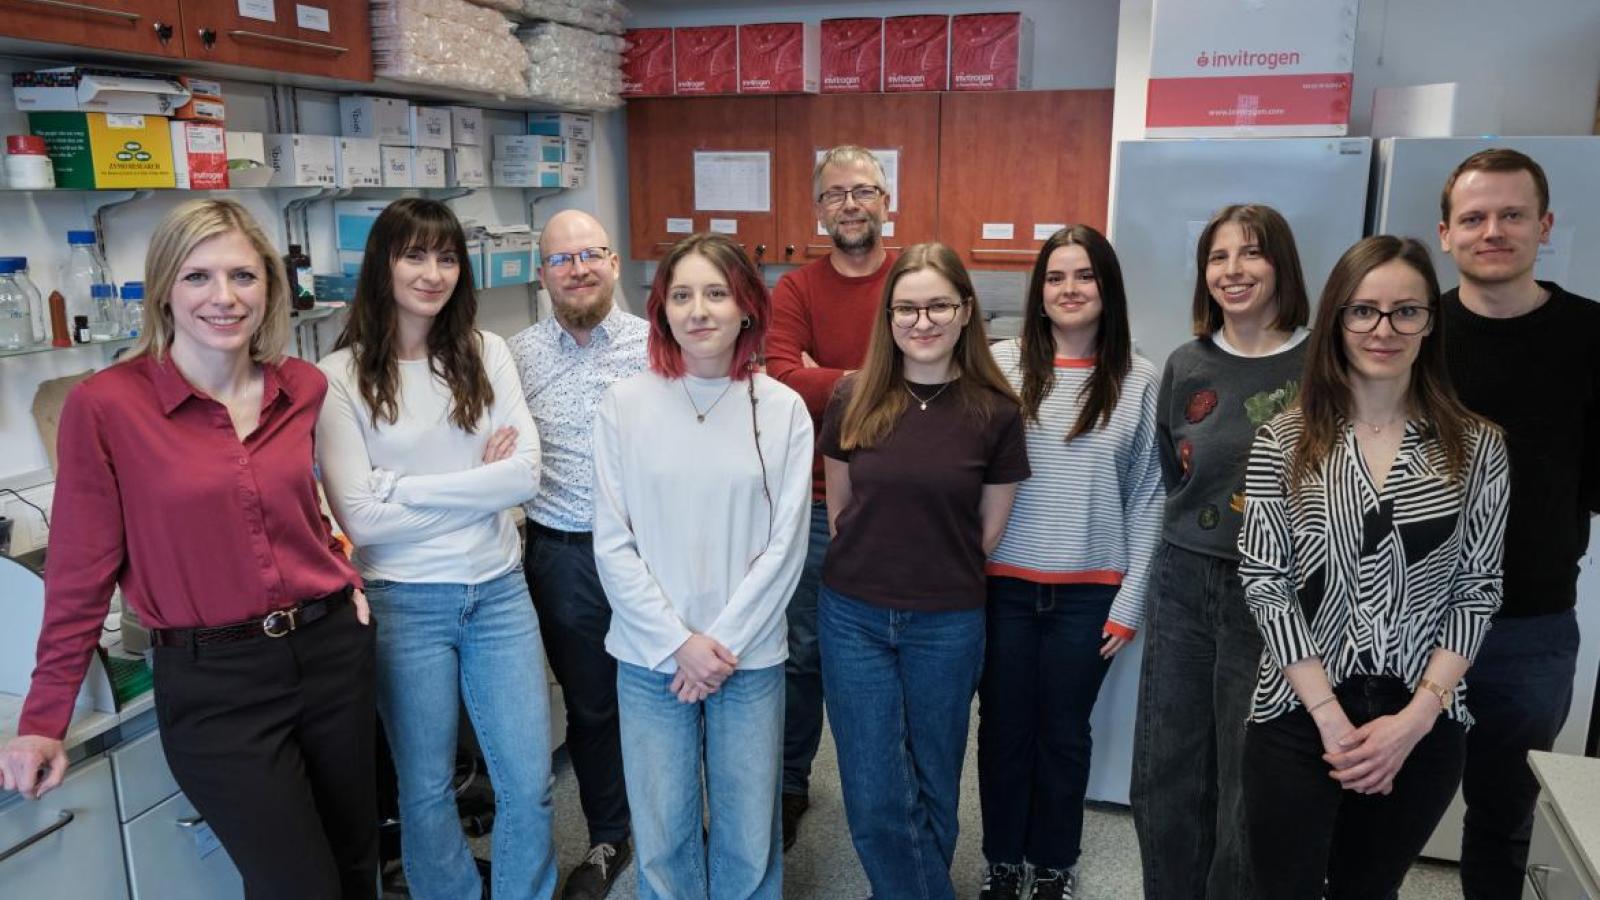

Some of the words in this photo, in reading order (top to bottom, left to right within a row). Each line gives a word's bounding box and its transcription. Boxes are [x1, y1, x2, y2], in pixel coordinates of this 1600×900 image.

[1212, 49, 1300, 70] invitrogen
[824, 76, 860, 85] invitrogen
[888, 75, 925, 84] invitrogen
[955, 73, 994, 83] invitrogen
